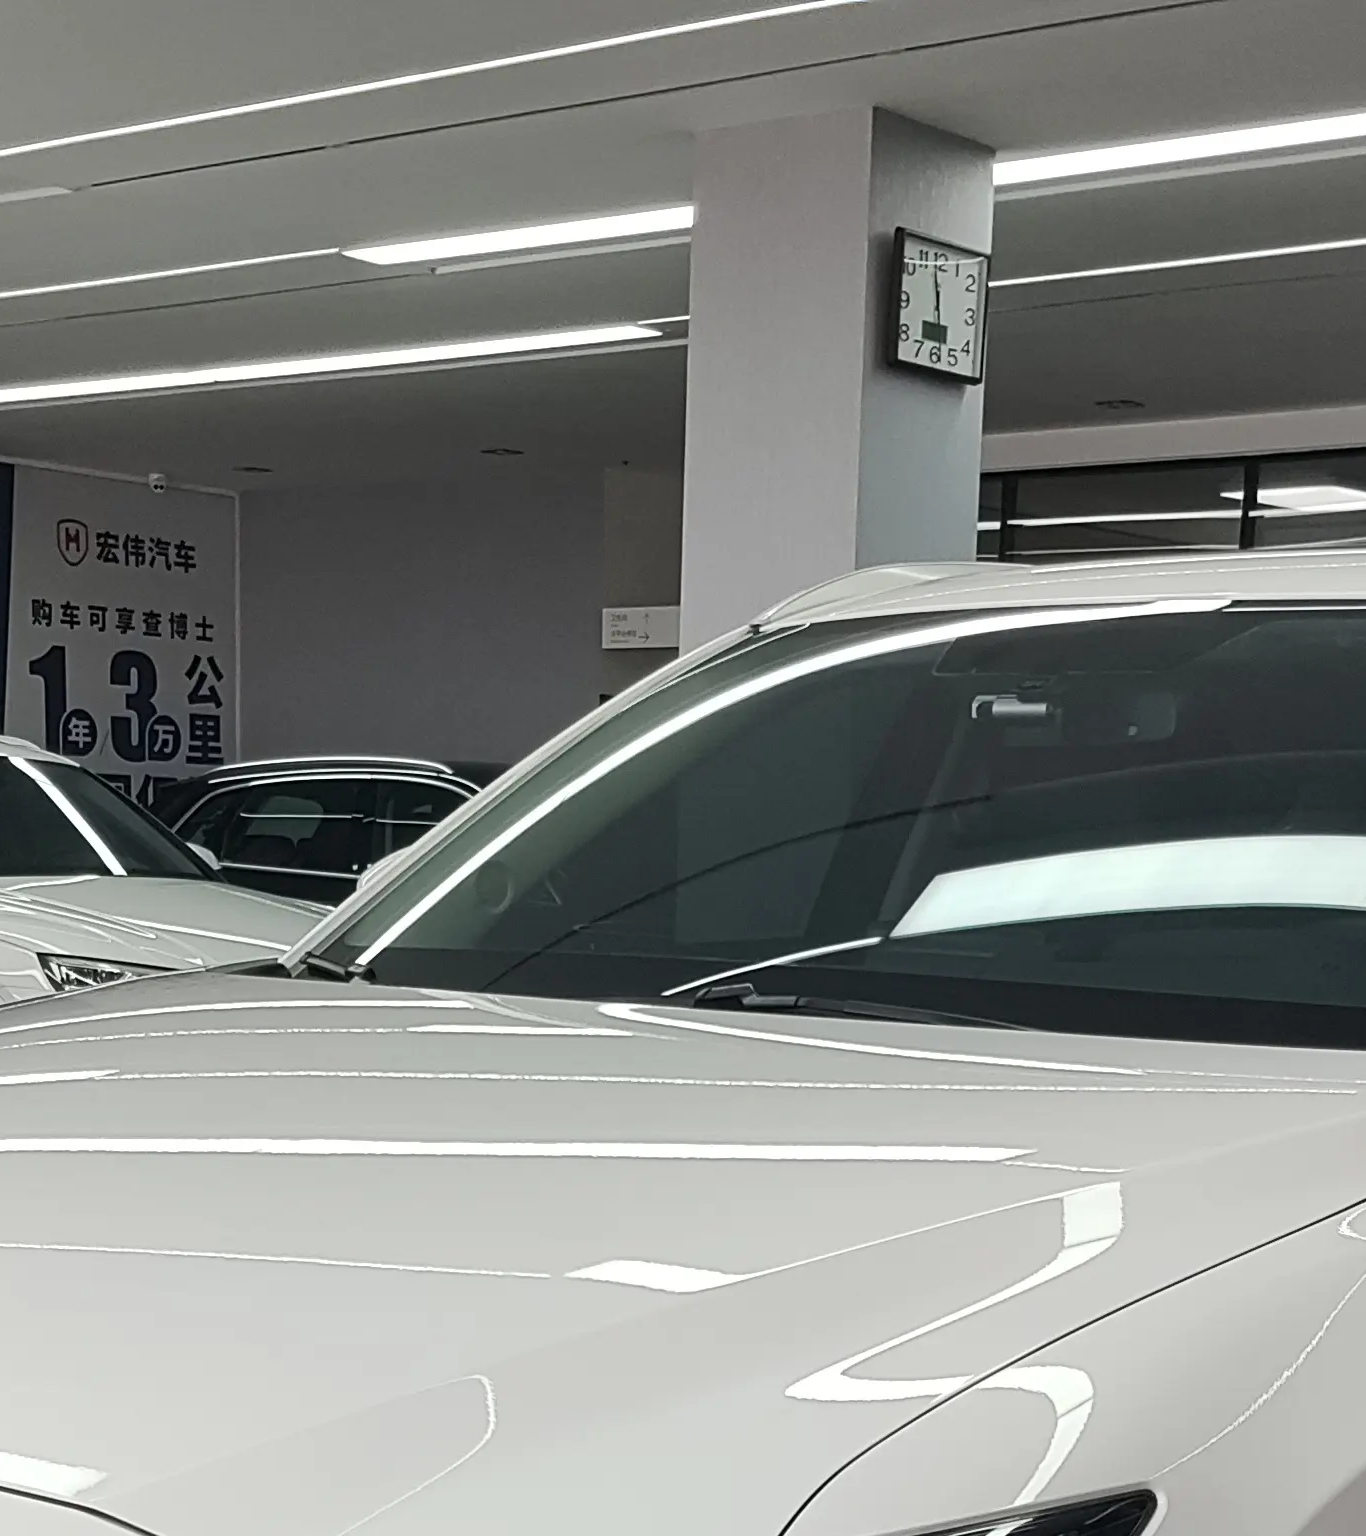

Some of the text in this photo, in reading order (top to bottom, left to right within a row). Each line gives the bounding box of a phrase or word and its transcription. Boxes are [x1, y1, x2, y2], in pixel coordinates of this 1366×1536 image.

[919, 249, 929, 269] 11
[934, 251, 948, 272] 12
[965, 274, 976, 293] 2
[900, 291, 910, 309] 9
[964, 308, 976, 327] 3
[899, 323, 910, 342] 8
[913, 339, 924, 358] 7
[929, 346, 941, 364] 6
[947, 348, 958, 366] 5
[960, 340, 971, 357] 4
[95, 531, 197, 573] 宏伟汽车
[31, 598, 214, 642] 购车可享查博士
